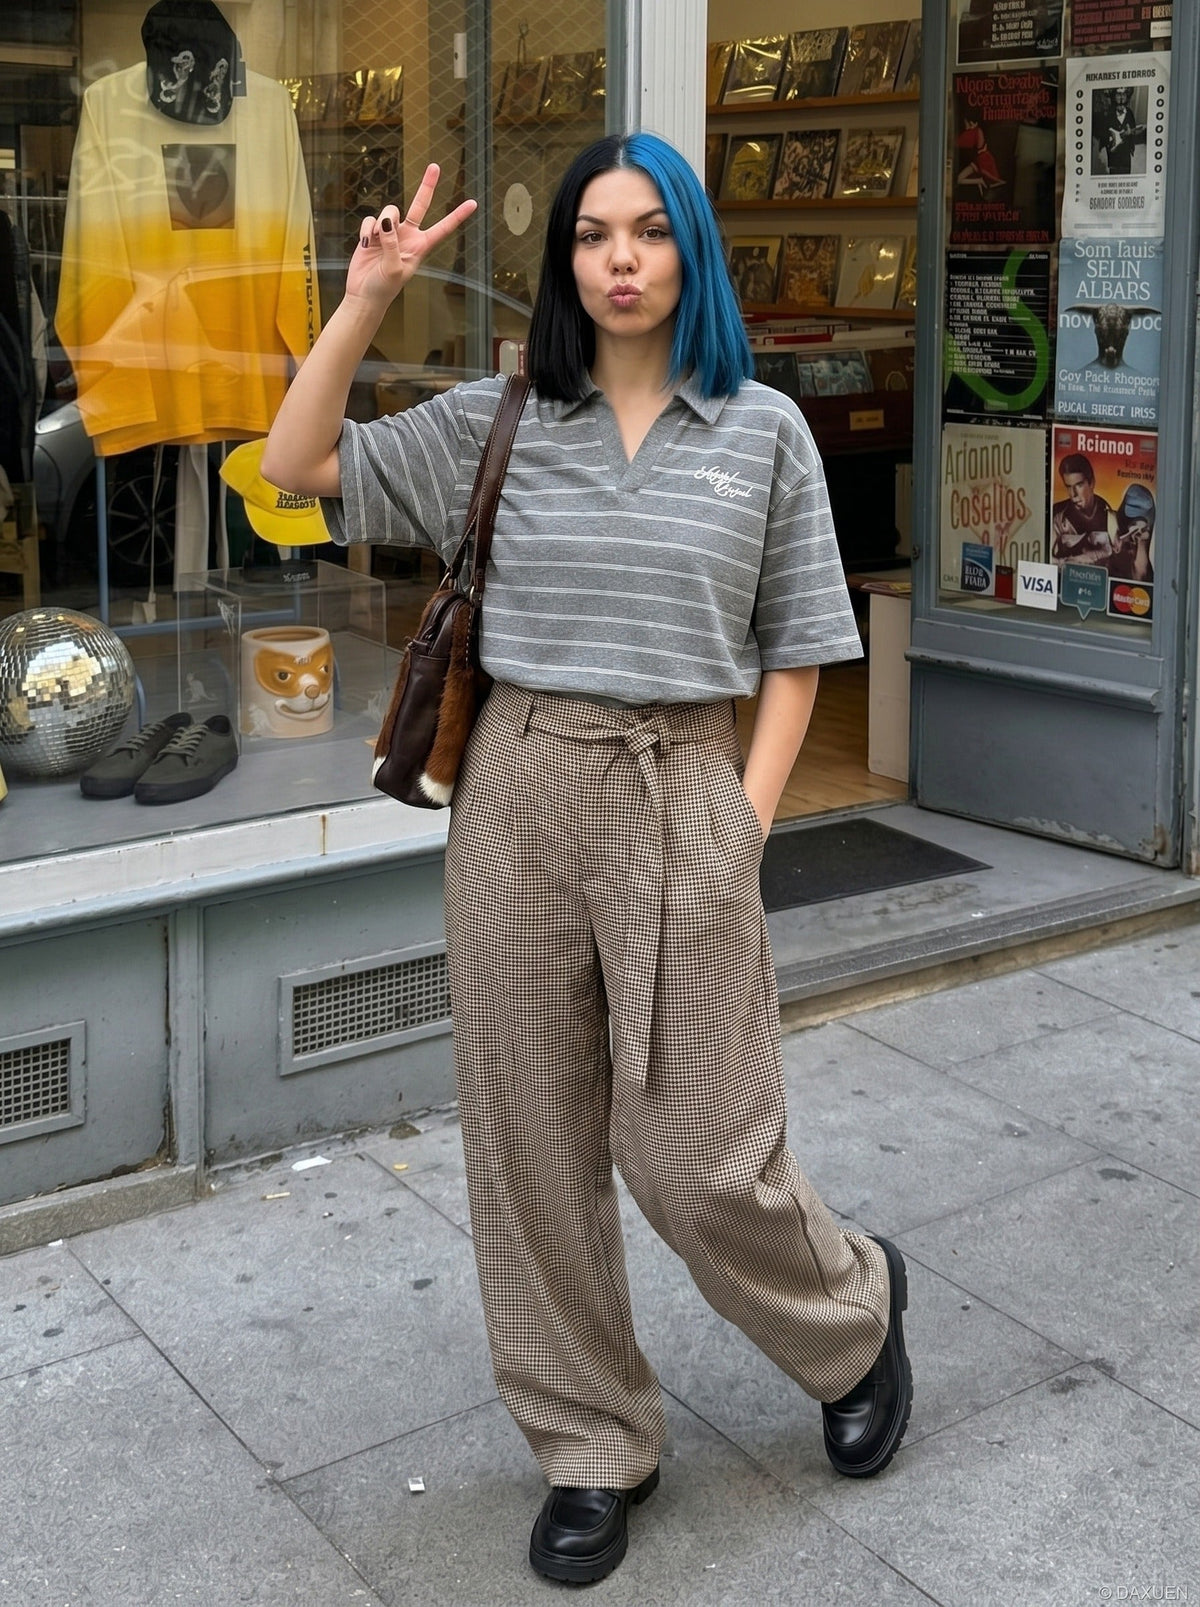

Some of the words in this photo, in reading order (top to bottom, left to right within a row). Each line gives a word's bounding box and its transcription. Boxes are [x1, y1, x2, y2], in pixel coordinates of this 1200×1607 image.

[1074, 240, 1112, 258] Som
[1087, 259, 1141, 279] SELIN
[1076, 280, 1151, 301] ALBARS
[1085, 370, 1110, 384] Pack
[1077, 433, 1134, 456] Rcianoo
[945, 441, 1013, 485] Arianno
[1021, 574, 1054, 594] VISA
